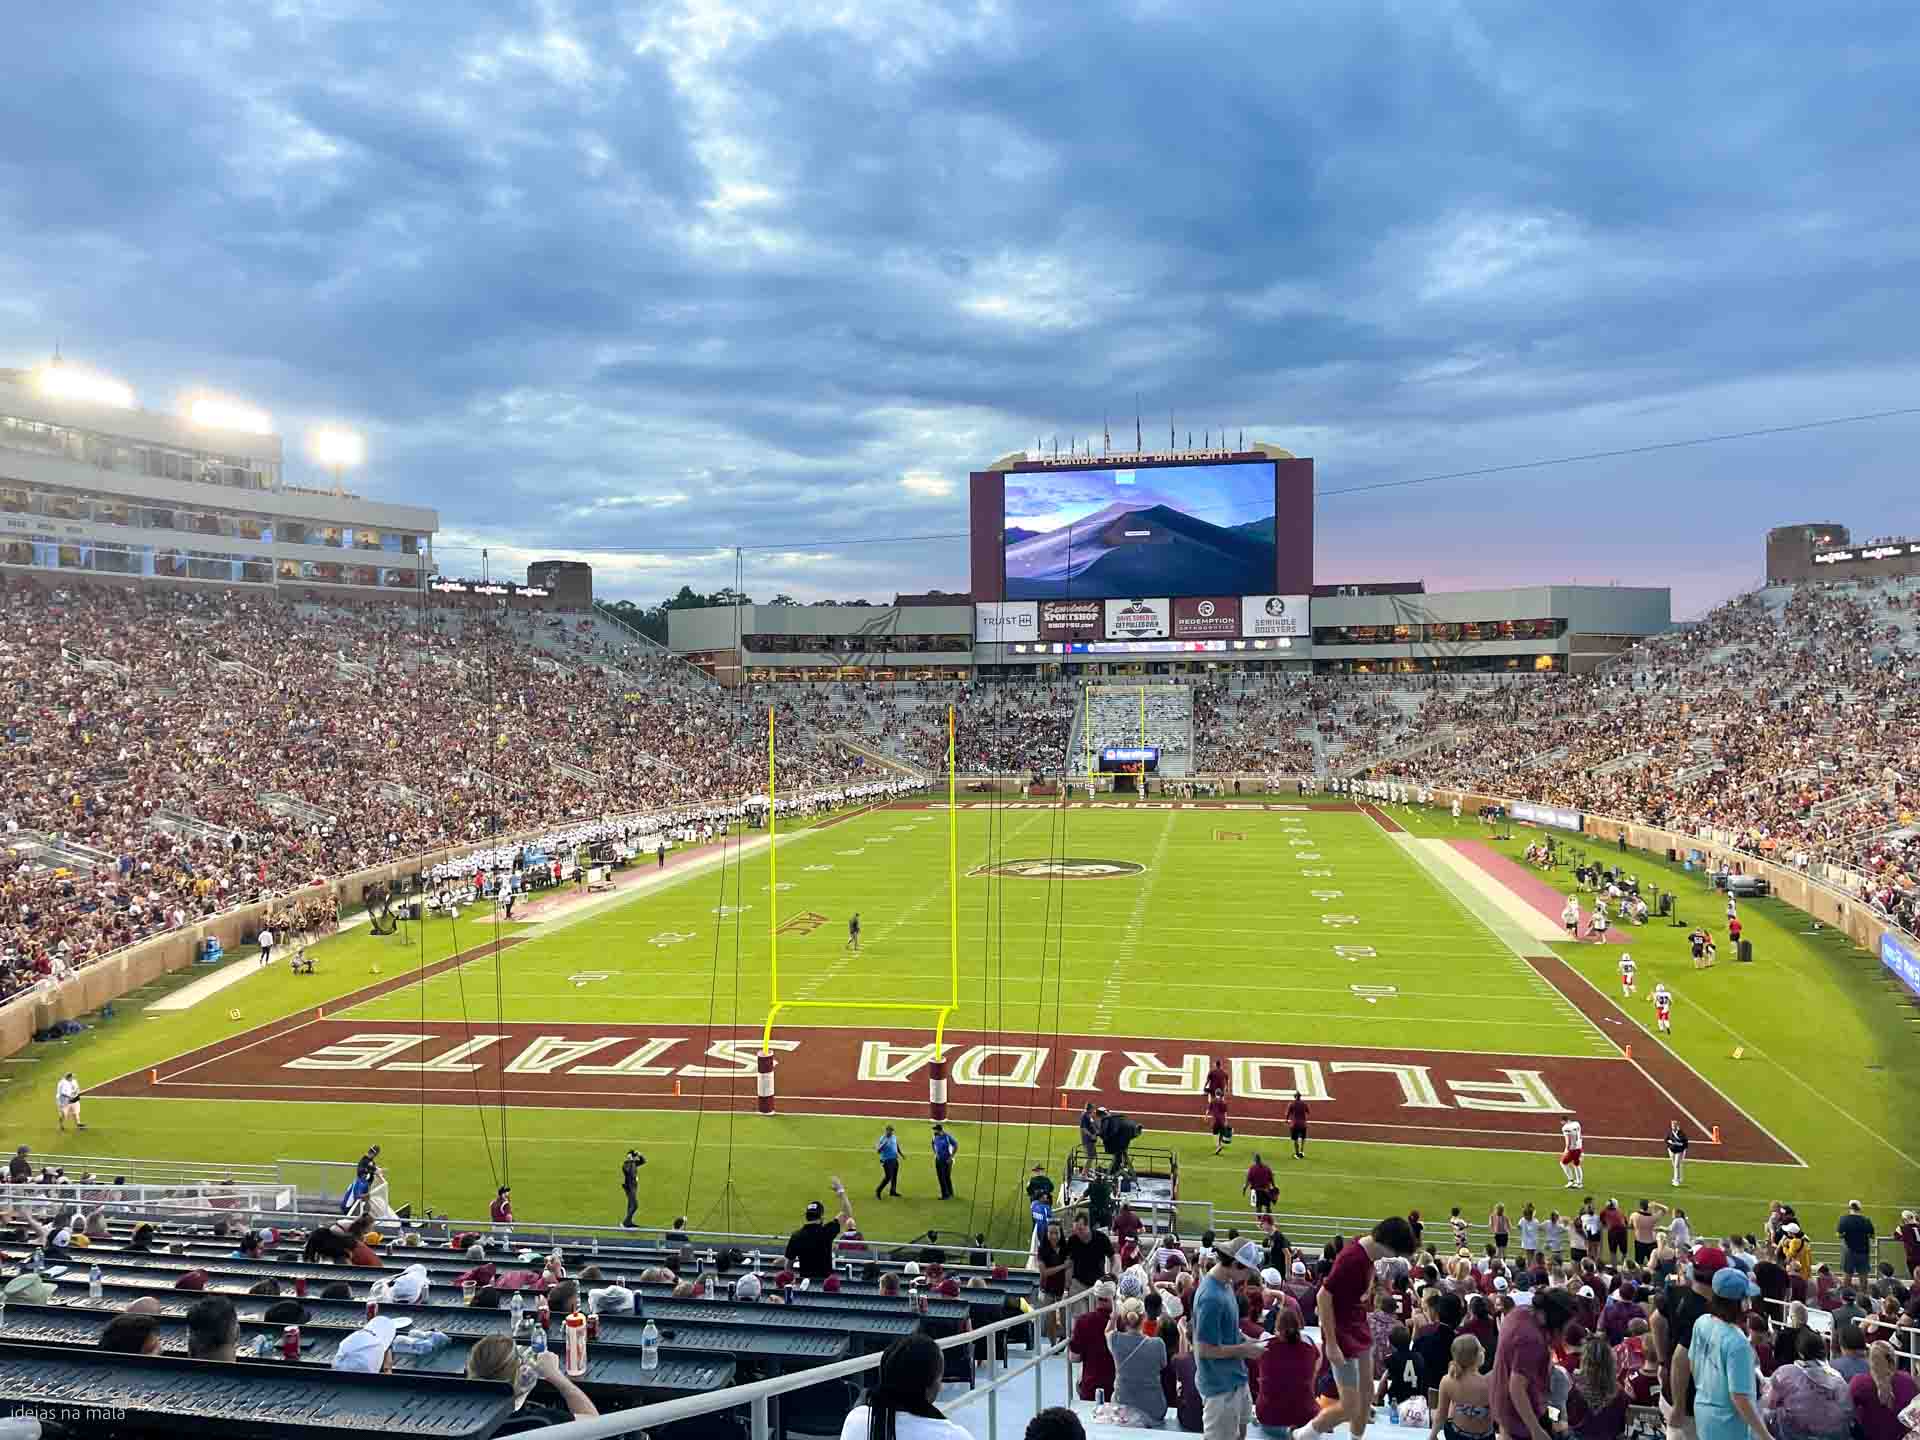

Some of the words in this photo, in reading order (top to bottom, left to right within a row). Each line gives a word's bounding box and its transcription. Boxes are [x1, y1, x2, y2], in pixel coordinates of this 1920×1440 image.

[1042, 456, 1098, 466] FLORIDA
[1105, 453, 1148, 464] STATE
[1154, 447, 1233, 462] UNIVERSITY
[984, 616, 1017, 625] TRUIST
[1044, 612, 1098, 622] SPORTSHOP
[1178, 617, 1235, 625] REDEMPTION
[1255, 618, 1297, 626] SEMINOLE
[1255, 626, 1297, 634] BOOSTERS
[281, 1034, 802, 1077] STATE
[856, 1040, 1576, 1115] FLORIDA
[1403, 1360, 1418, 1388] 4
